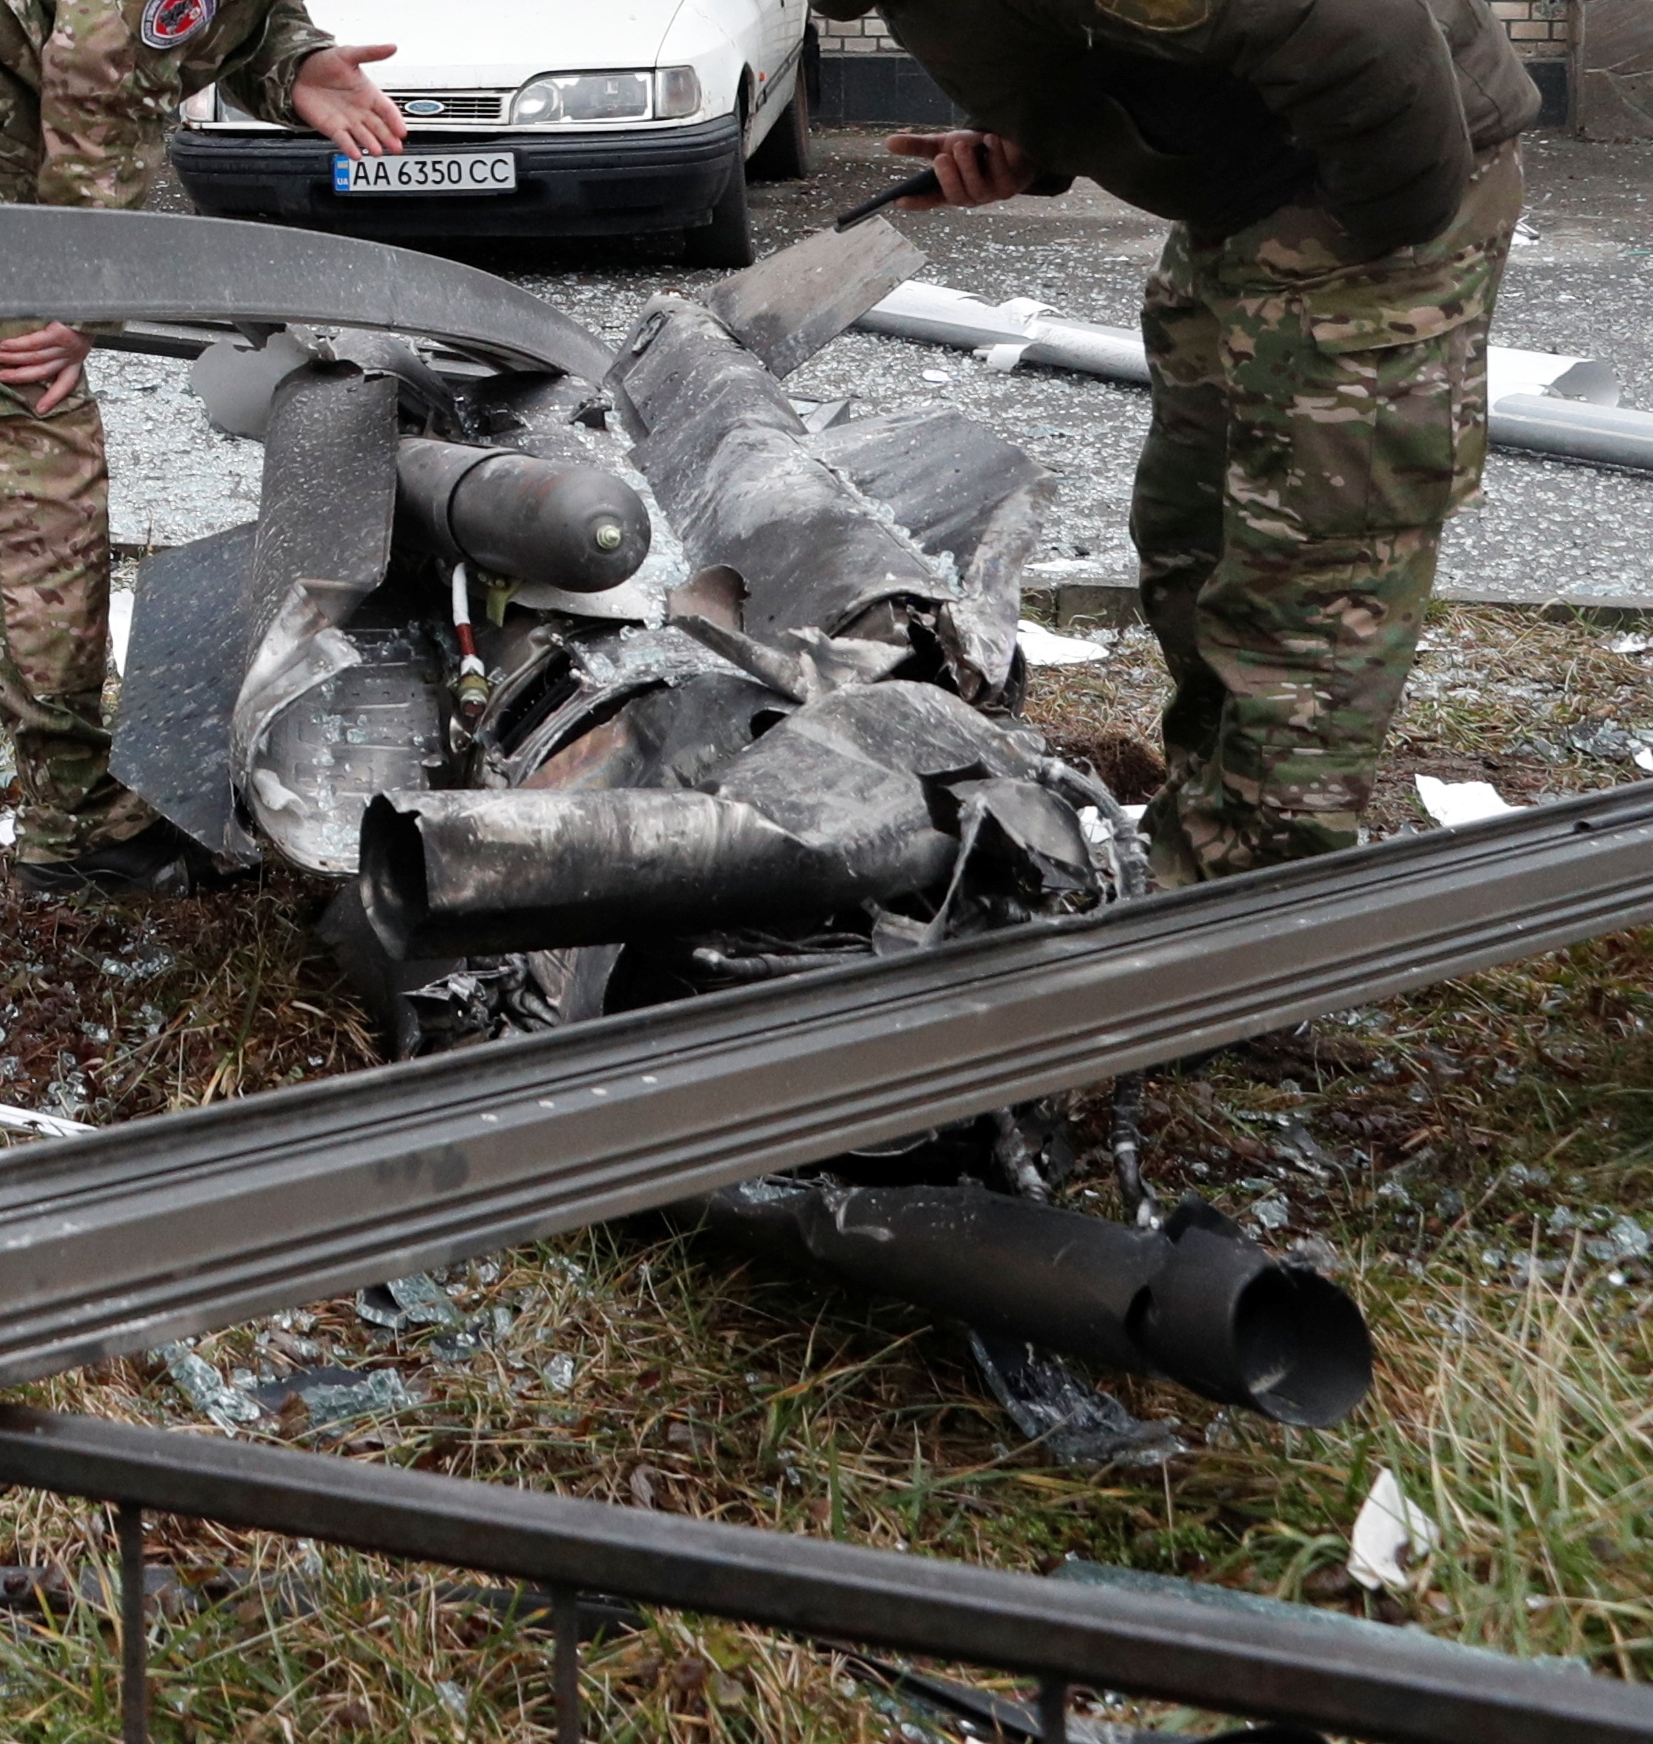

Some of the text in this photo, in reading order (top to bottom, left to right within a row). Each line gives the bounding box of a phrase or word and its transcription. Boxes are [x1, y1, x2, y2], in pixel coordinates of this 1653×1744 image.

[353, 159, 509, 186] AA 6350 CC
[337, 178, 349, 186] UA
